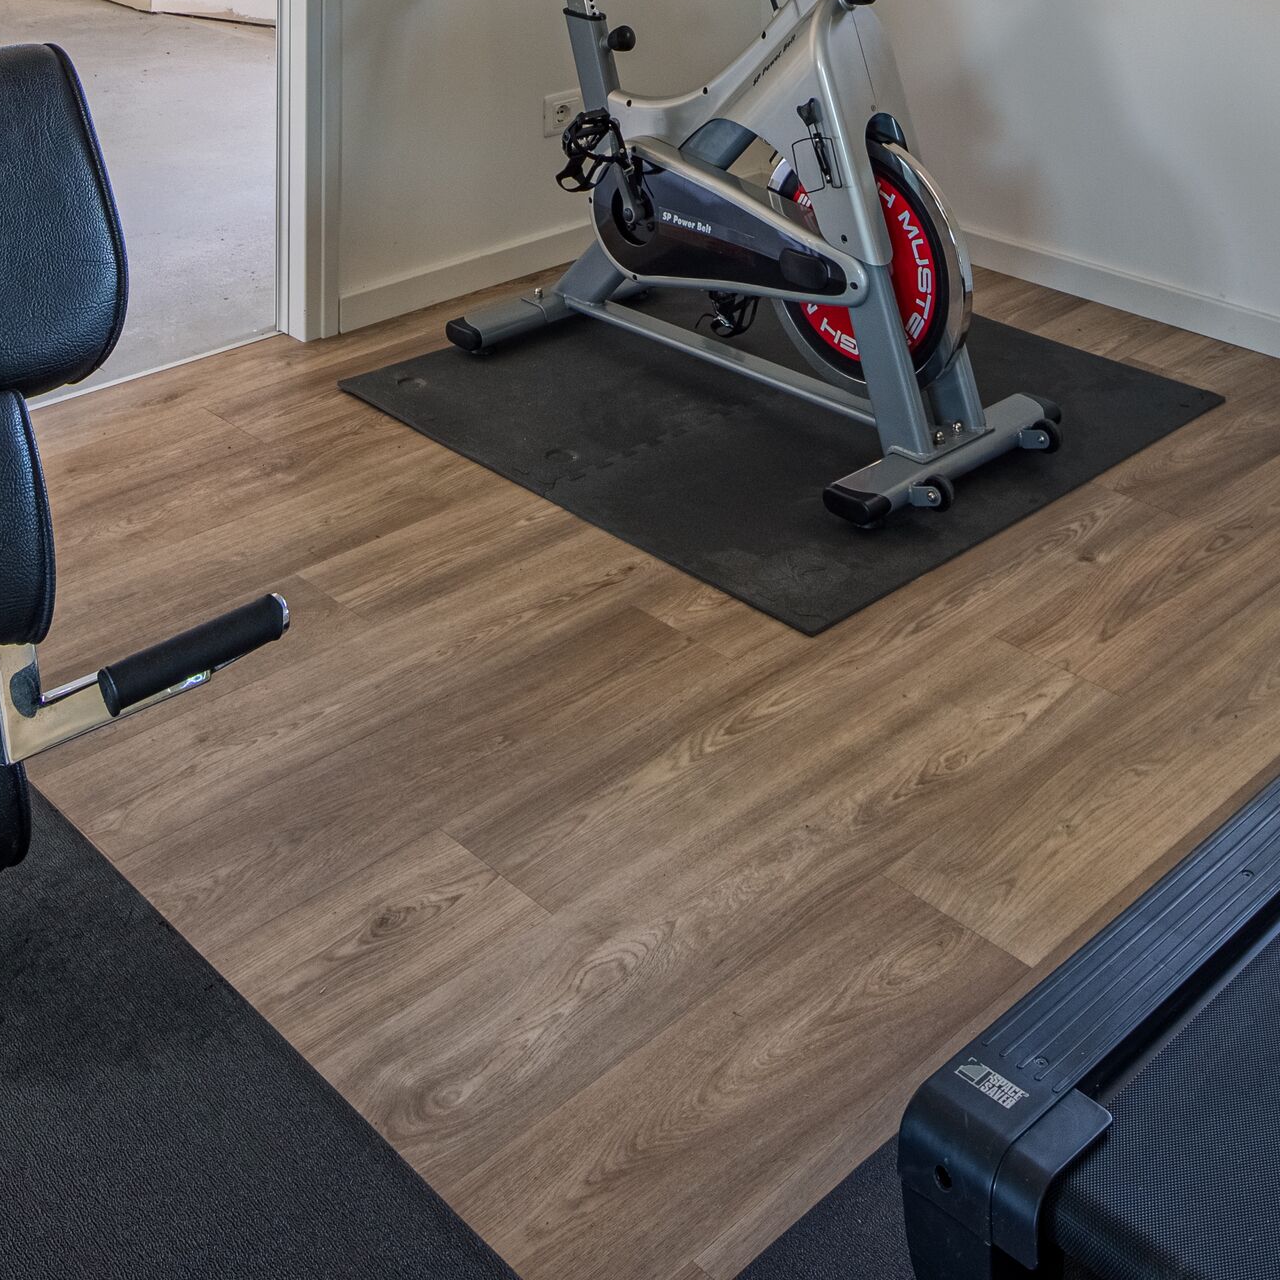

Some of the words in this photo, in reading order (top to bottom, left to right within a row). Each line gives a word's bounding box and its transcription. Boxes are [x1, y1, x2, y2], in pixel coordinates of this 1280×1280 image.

[662, 211, 672, 222] SP
[673, 214, 696, 229] Power
[898, 210, 933, 345] MUSTE
[980, 1081, 1018, 1110] SAVER
[990, 1072, 1026, 1101] SPACE
